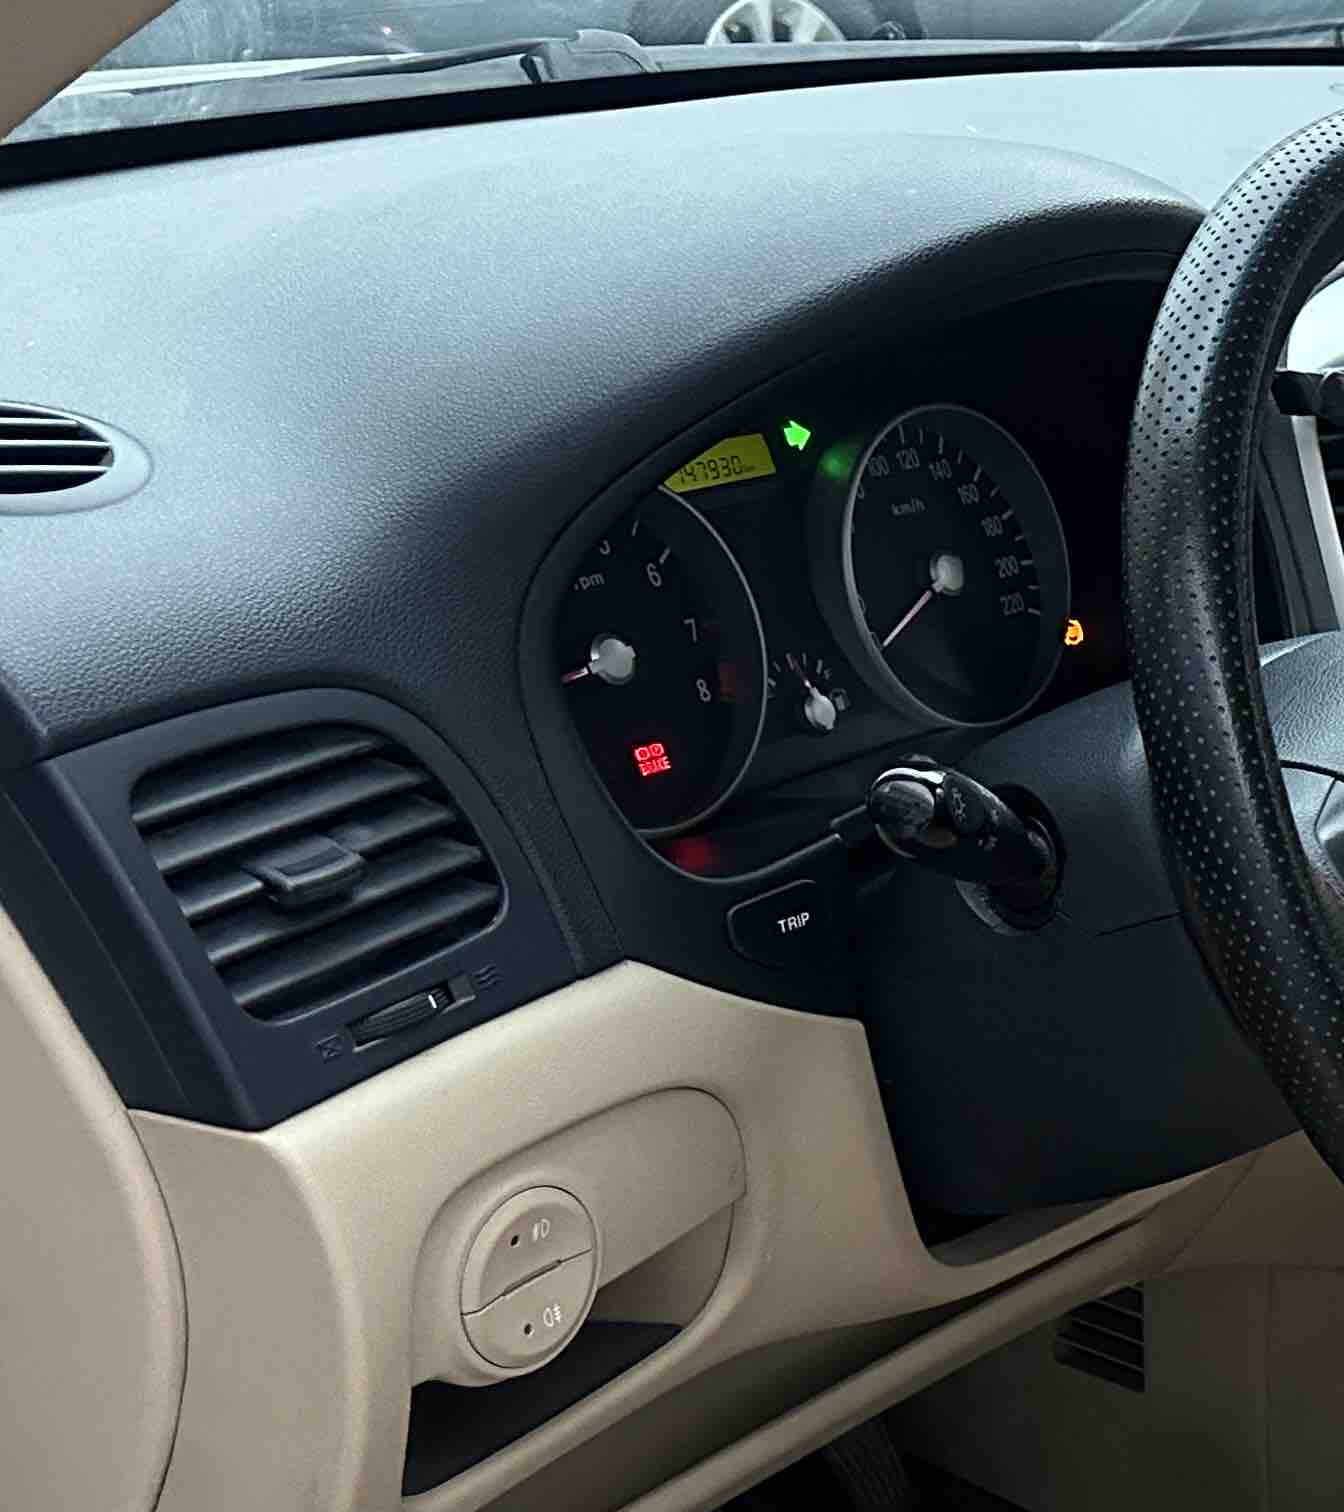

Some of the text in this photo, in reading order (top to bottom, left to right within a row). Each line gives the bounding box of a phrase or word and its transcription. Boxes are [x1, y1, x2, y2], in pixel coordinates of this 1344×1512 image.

[646, 562, 662, 587] 6
[683, 618, 698, 643] 7
[696, 678, 711, 702] 8
[777, 911, 810, 934] TRIP
